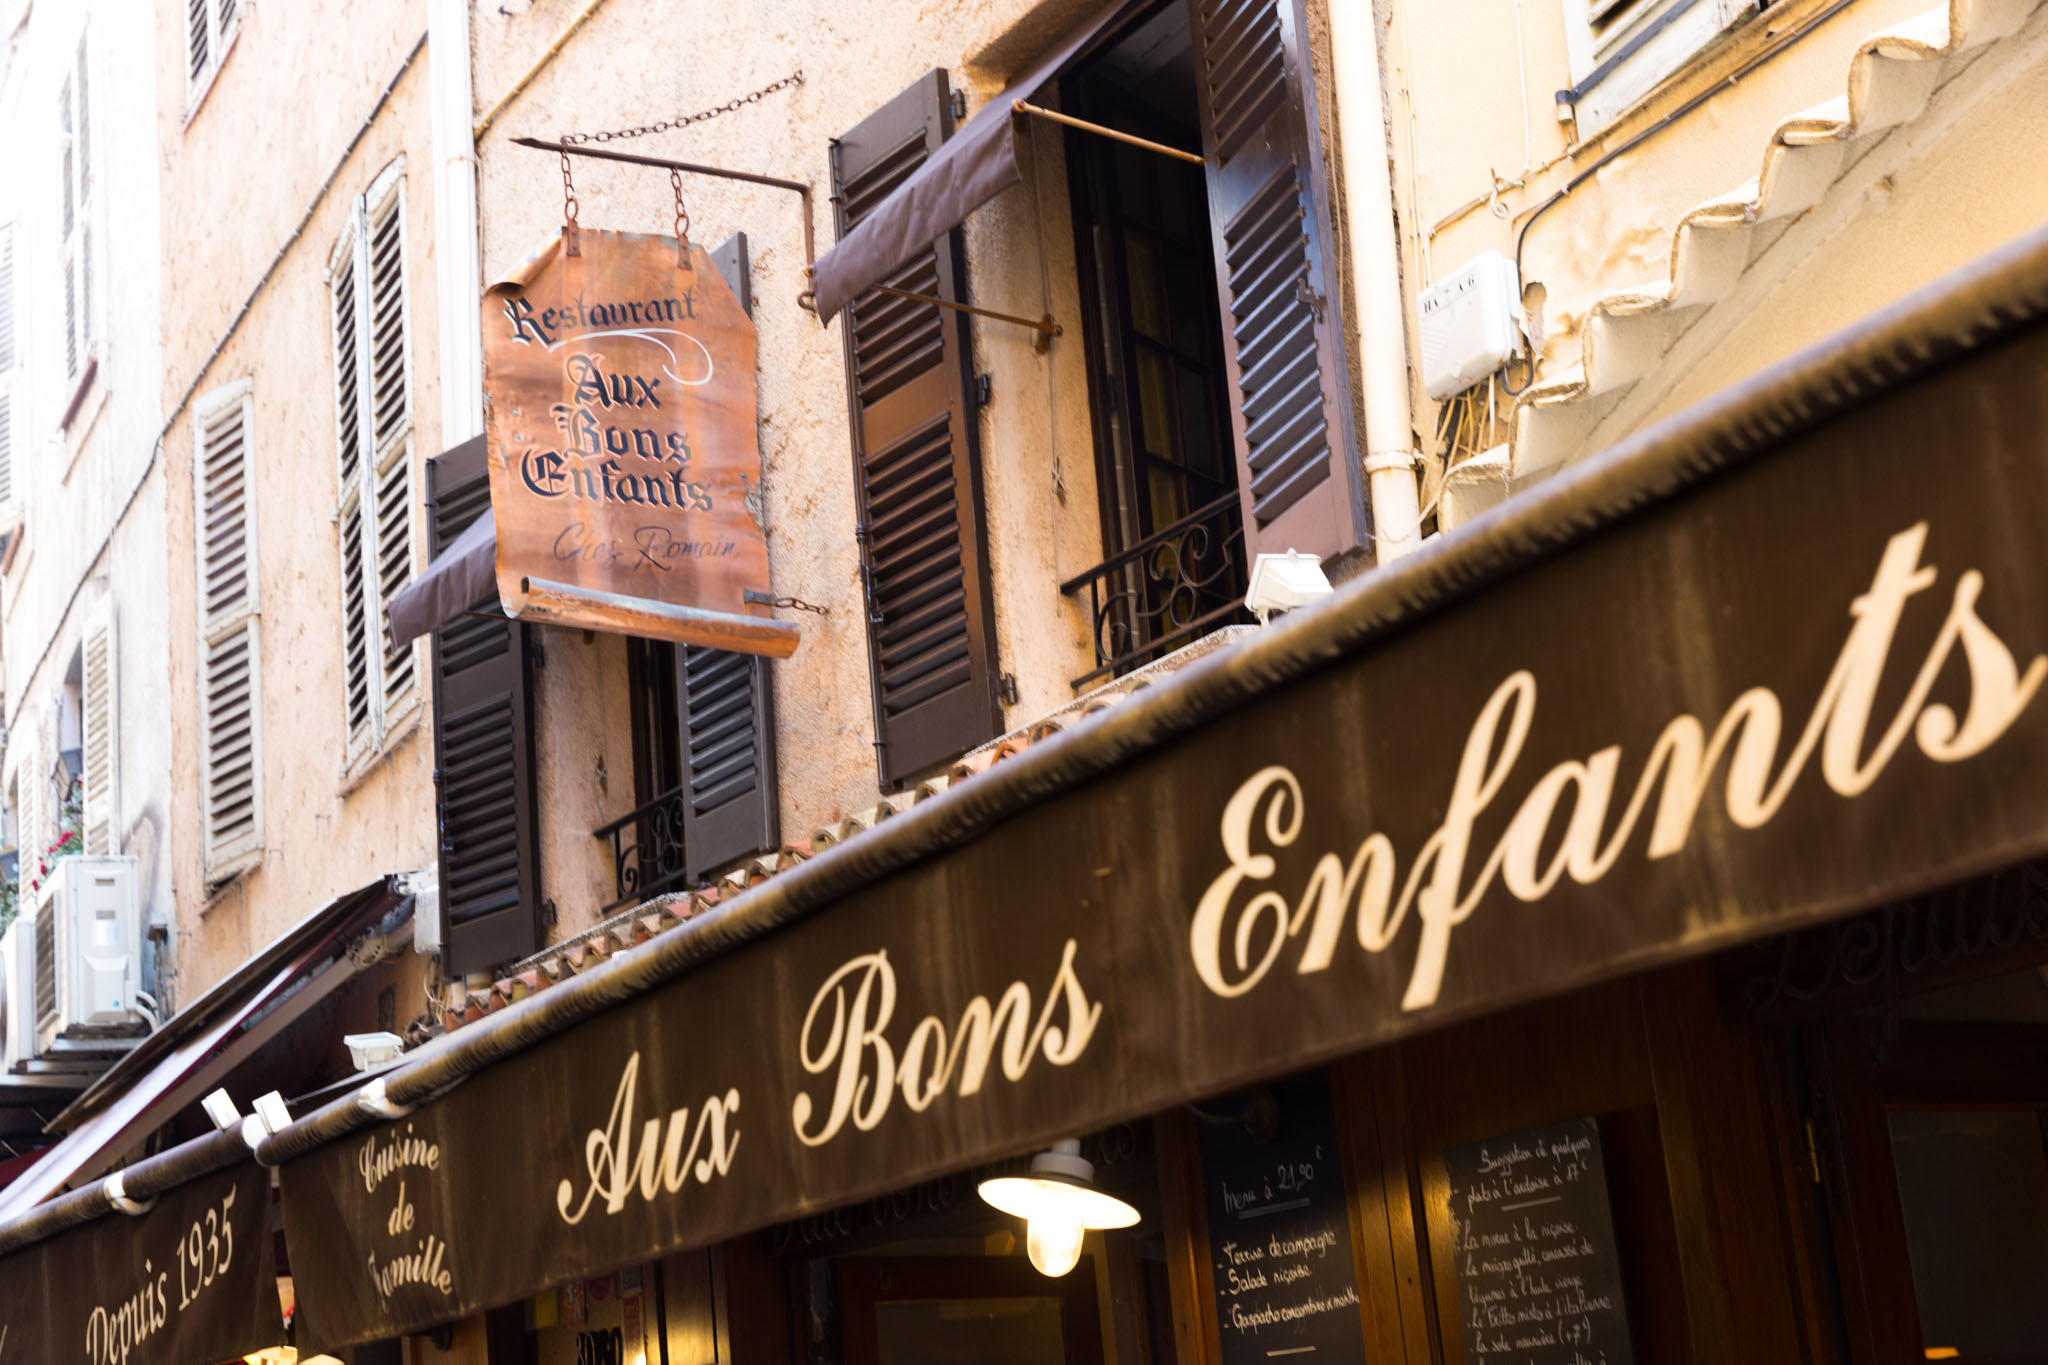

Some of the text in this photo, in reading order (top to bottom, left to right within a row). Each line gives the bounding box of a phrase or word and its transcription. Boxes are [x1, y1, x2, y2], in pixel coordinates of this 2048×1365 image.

[503, 290, 698, 353] Restaurant
[566, 353, 662, 411] Aux
[551, 403, 692, 464] Bons
[520, 445, 714, 512] Enfants
[554, 522, 615, 569] Chez
[557, 521, 2048, 1225] Aux Bons Enfants
[359, 1122, 439, 1193] Cuisine
[388, 1181, 415, 1236] de
[86, 1183, 236, 1365] Depuis 1935
